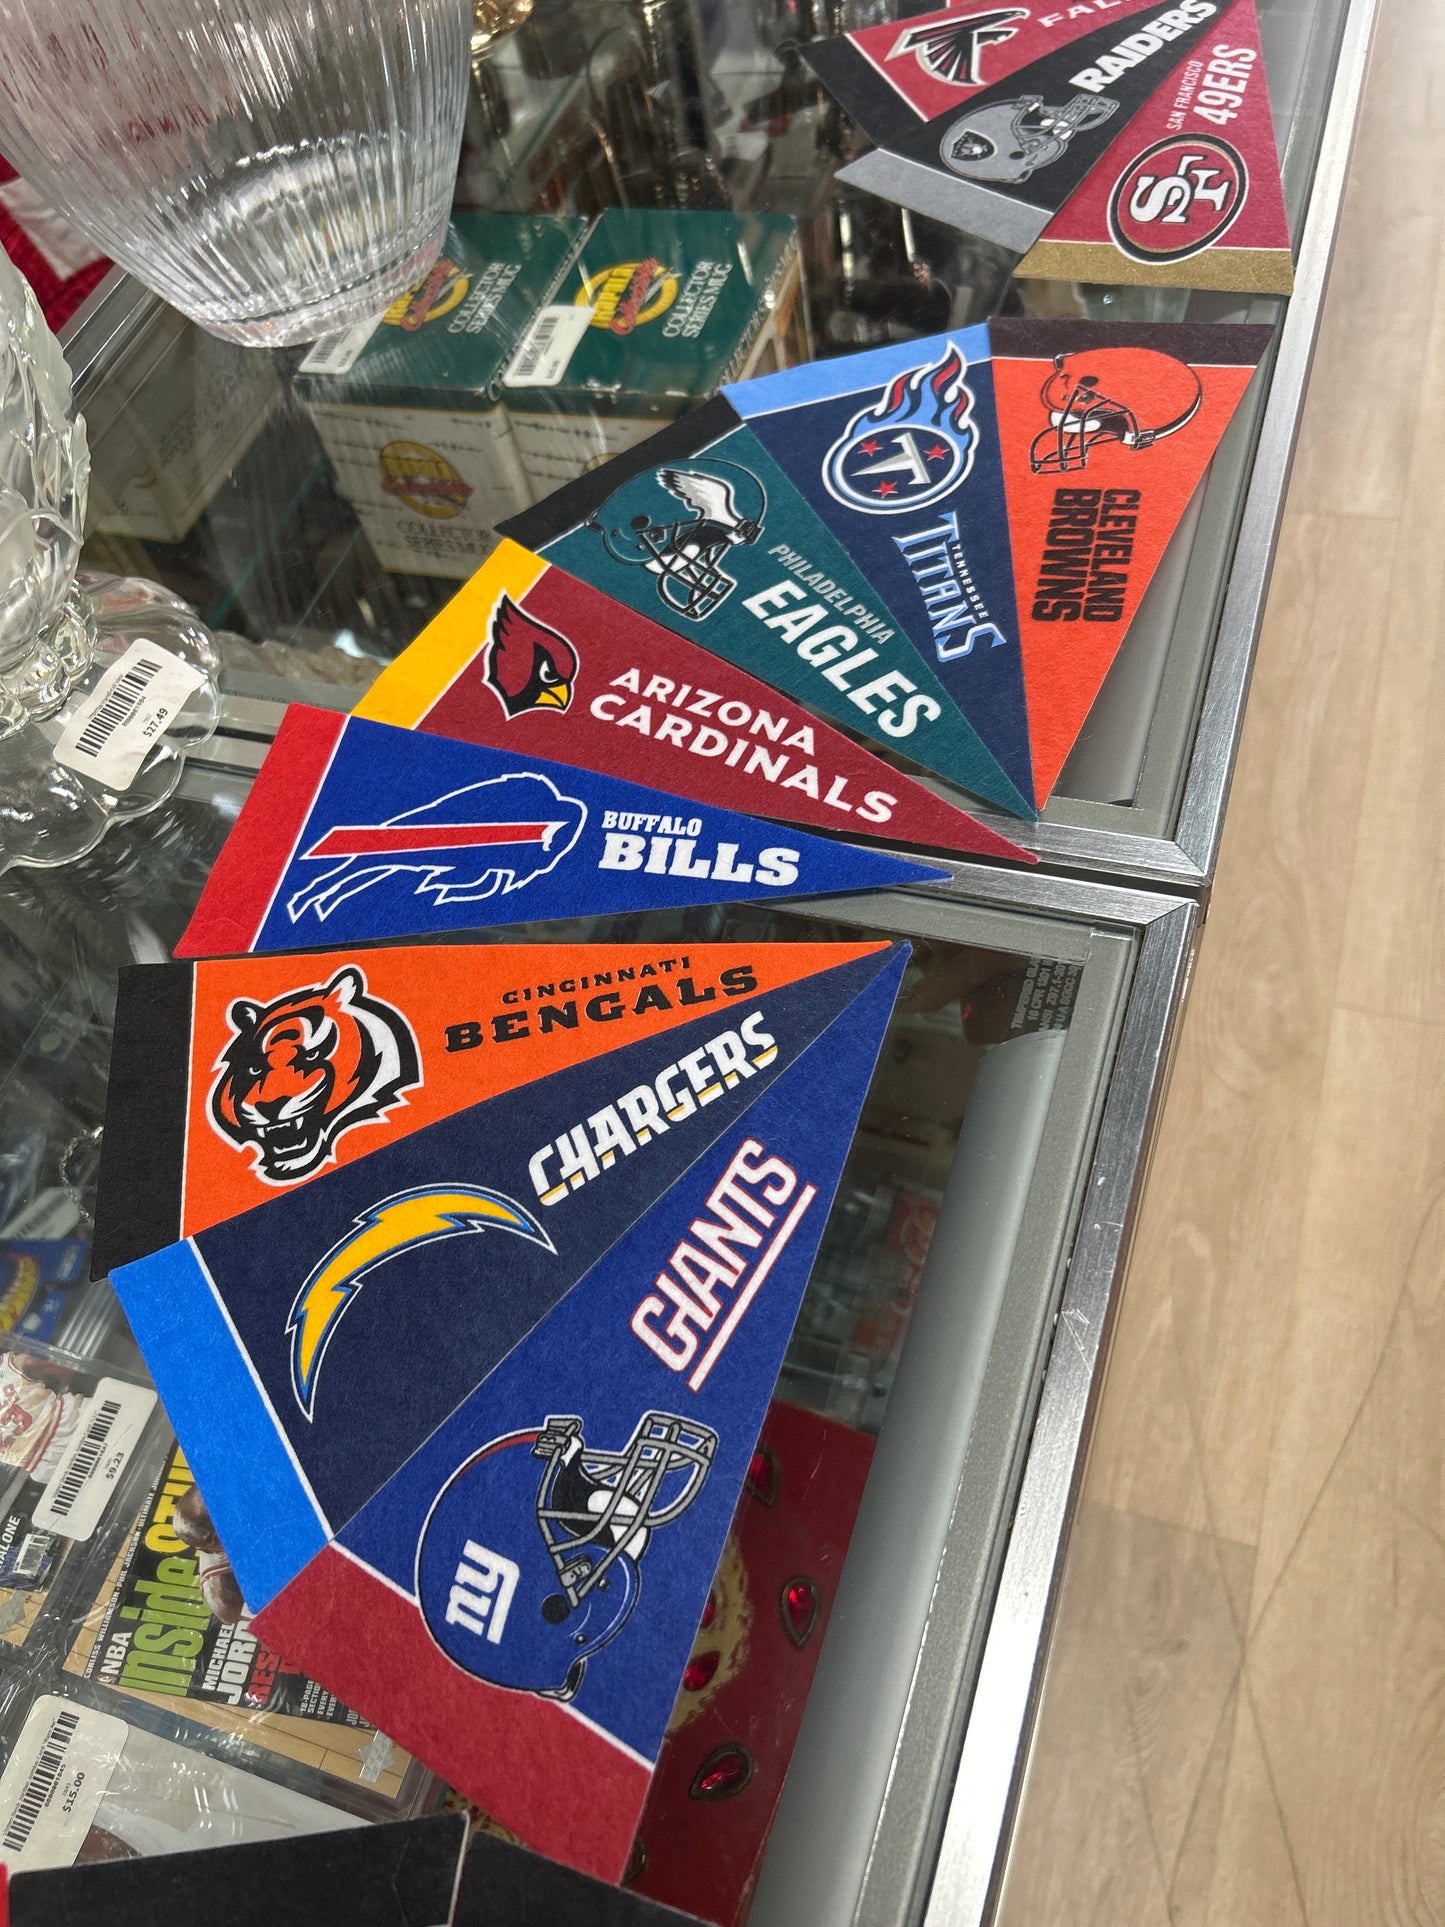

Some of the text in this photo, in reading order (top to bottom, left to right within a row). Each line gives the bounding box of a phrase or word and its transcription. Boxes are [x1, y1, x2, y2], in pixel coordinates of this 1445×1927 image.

[1038, 0, 1138, 28] FAL
[1069, 0, 1217, 93] RAIDERS
[1166, 60, 1203, 131] SAN FRANCISCO
[1193, 45, 1257, 125] 49ERS
[447, 262, 505, 333] COLLECTOR
[662, 261, 715, 337] COLLECTOR
[682, 293, 718, 338] SERIES
[892, 511, 1007, 662] TITANS
[951, 544, 989, 619] TENNESSEE
[1031, 488, 1102, 622] BROWNS
[1082, 489, 1141, 622] CLEVELAND
[768, 543, 896, 644] PHILADELPHIA
[742, 580, 941, 737] EAGLES
[143, 708, 168, 738] $27.49
[609, 668, 816, 757] ARIZONA
[590, 694, 897, 823] CARDINALS
[598, 832, 800, 886] BILLS
[601, 810, 702, 836] BUFFALO
[444, 965, 758, 1053] BENGALS
[502, 956, 691, 1004] CINCINNATI
[528, 1011, 778, 1206] CHARGERS
[630, 1137, 800, 1372] GIANTS
[106, 1452, 124, 1480] $9.23
[83, 1491, 155, 1678] CORLISS WILLIAMSON PHIL JACKSON ULTIMATE
[101, 1632, 132, 1679] NBA
[118, 1557, 213, 1697] inside
[202, 1623, 236, 1691] MICHAEL
[247, 1643, 279, 1705] RES
[307, 1682, 321, 1714] SECTIO
[317, 1689, 329, 1715] EVERY
[326, 1694, 337, 1716] EVER
[63, 1772, 86, 1813] $15.00
